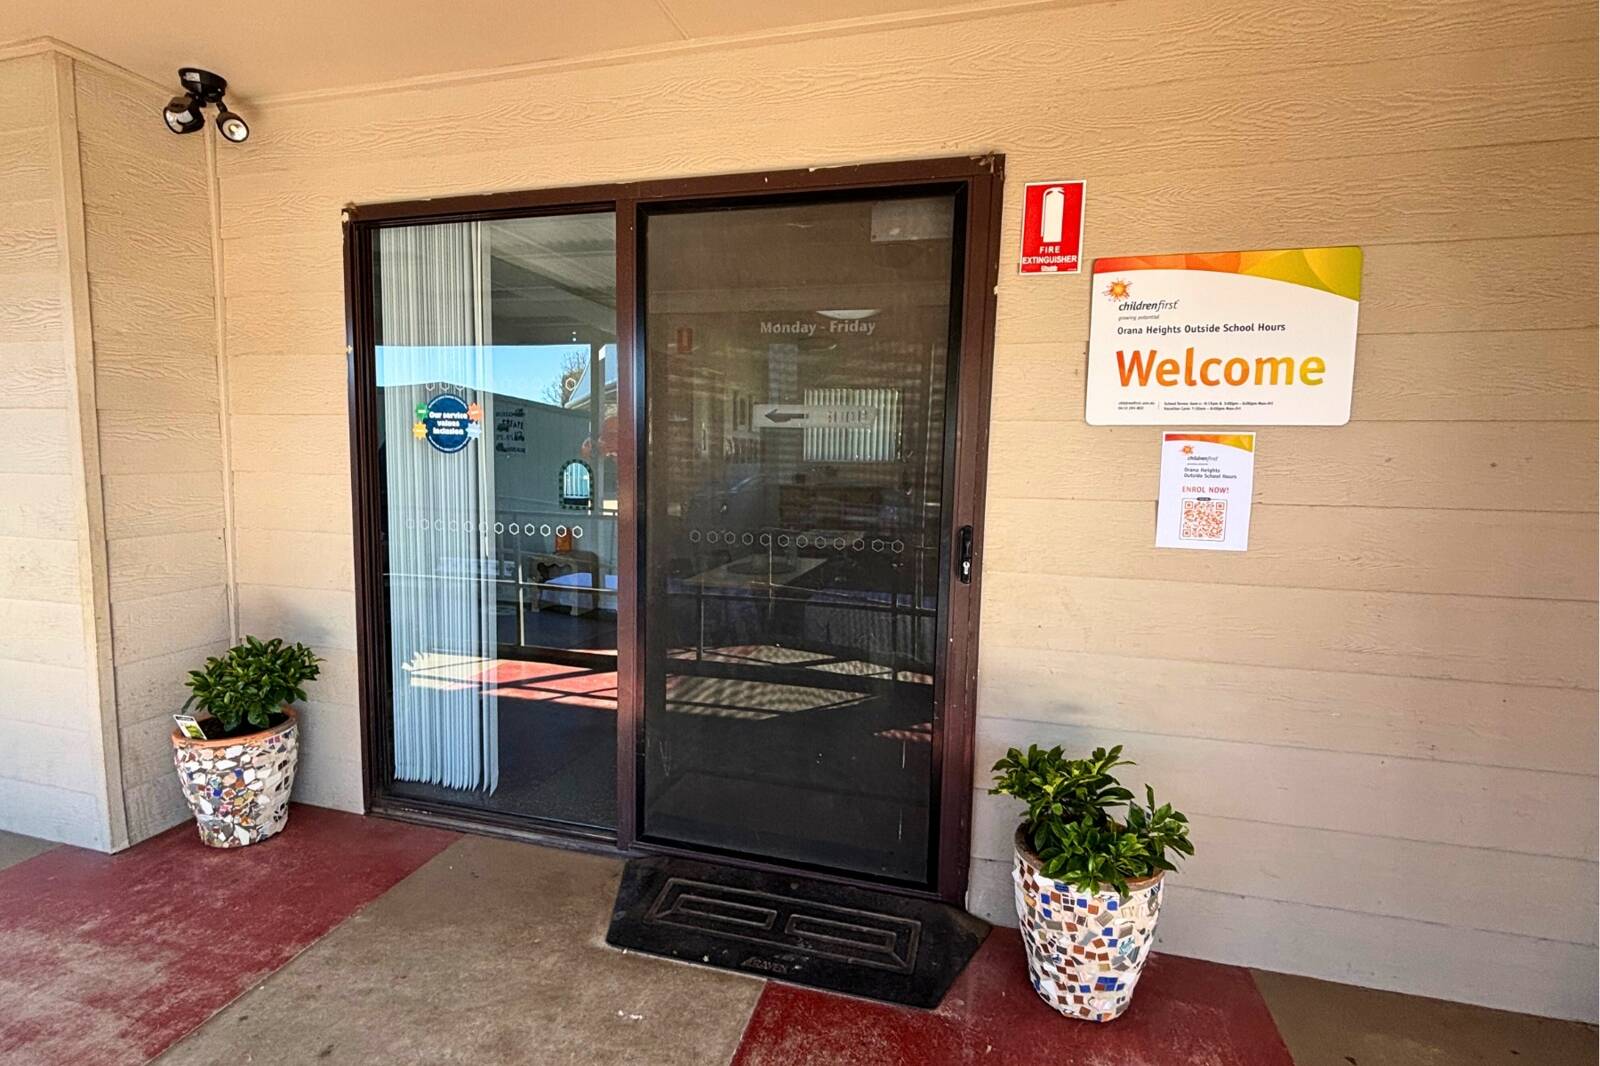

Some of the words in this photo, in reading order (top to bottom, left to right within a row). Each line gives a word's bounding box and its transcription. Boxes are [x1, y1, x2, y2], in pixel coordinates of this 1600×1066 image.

[1039, 245, 1061, 254] FIRE
[1022, 255, 1078, 265] EXTINGUISHER
[760, 321, 817, 337] Monday
[829, 320, 876, 336] Friday
[1117, 326, 1143, 335] Orana
[1146, 325, 1182, 336] Heights
[1184, 324, 1221, 333] Outside
[1223, 323, 1255, 332] School
[1258, 323, 1287, 331] Hours
[1116, 347, 1326, 387] Welcome
[429, 411, 442, 419] Our
[443, 411, 468, 420] service
